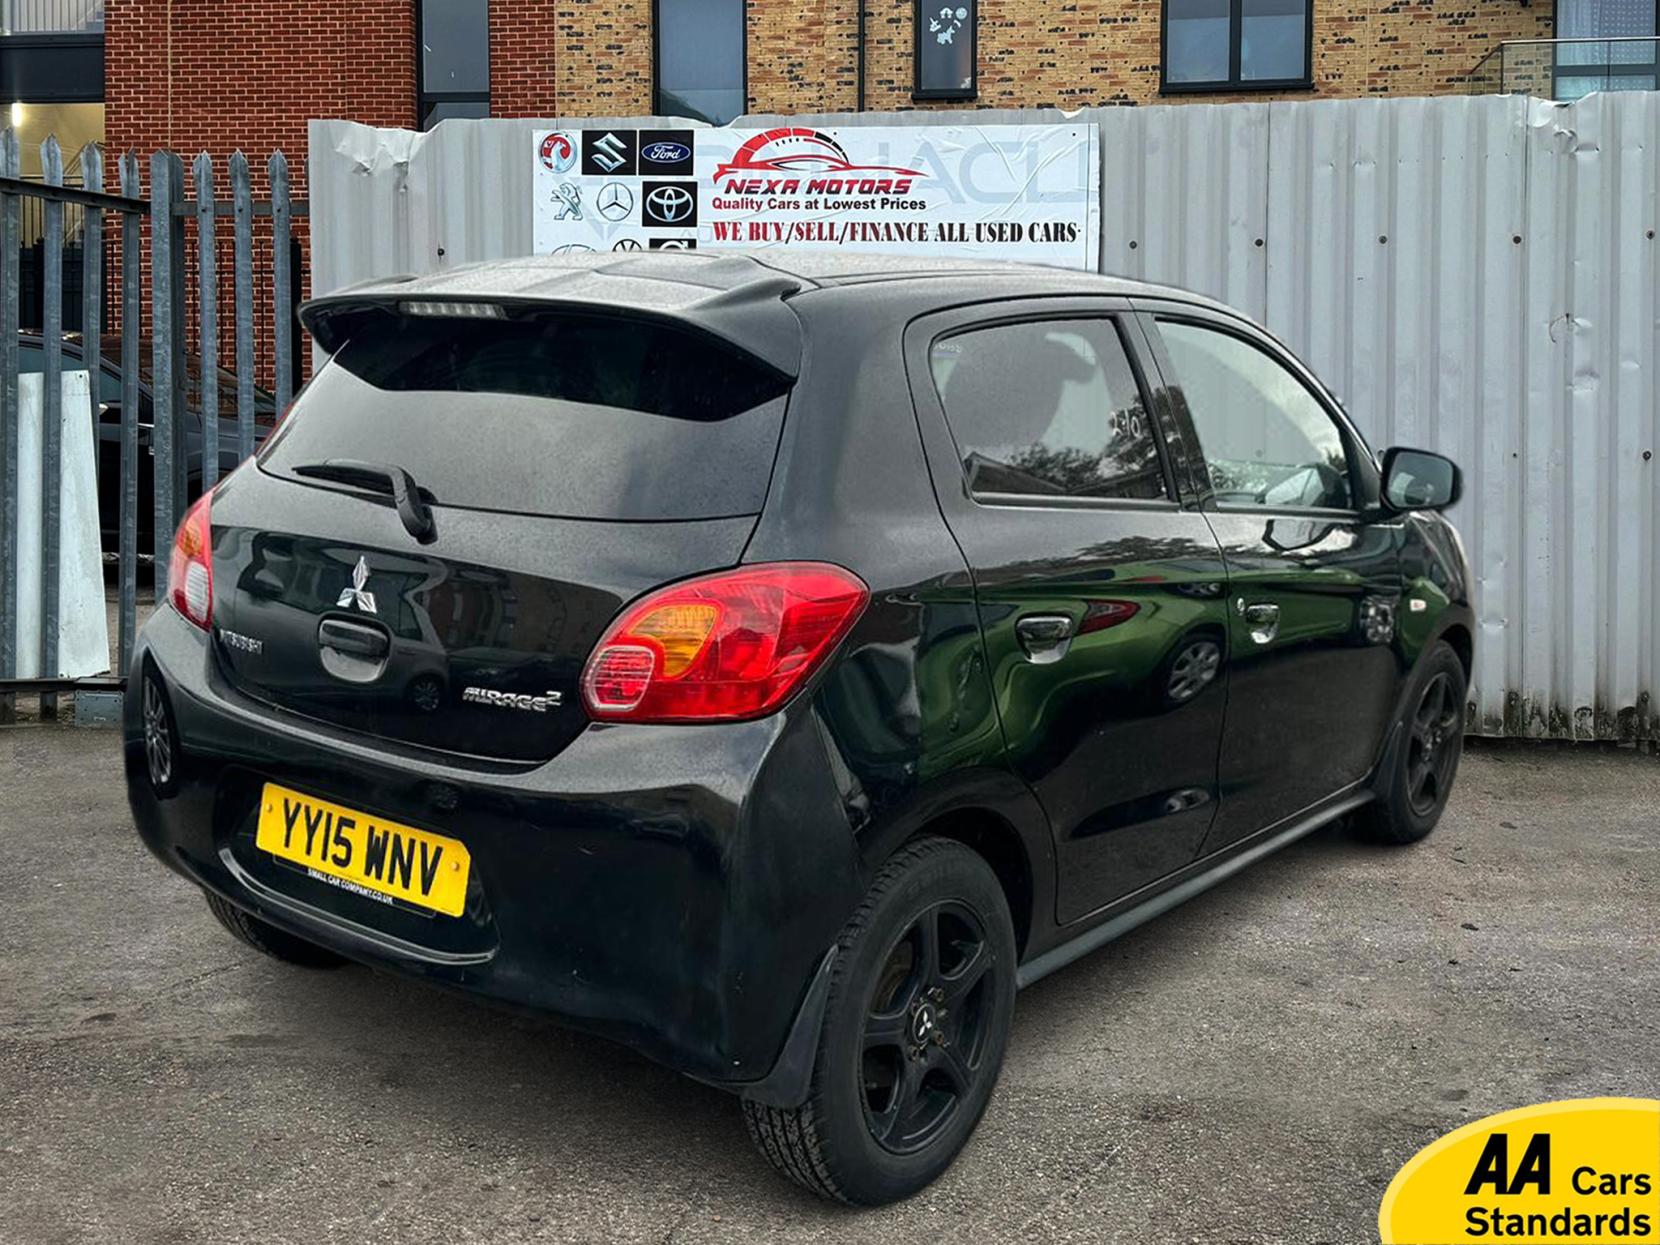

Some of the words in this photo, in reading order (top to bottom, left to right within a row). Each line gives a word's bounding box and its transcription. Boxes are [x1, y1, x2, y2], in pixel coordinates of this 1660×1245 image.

[651, 145, 681, 159] Ford
[724, 179, 797, 195] NEXA
[805, 179, 912, 195] MOTORS
[712, 197, 763, 211] Quality
[767, 198, 801, 210] Cars
[804, 199, 820, 210] at
[823, 198, 877, 210] Lowest
[880, 198, 927, 210] Prices
[713, 221, 743, 241] WE
[748, 221, 929, 245] BUY/SELL/FINANCE
[934, 222, 970, 243] ALL
[975, 222, 1023, 243] USED
[284, 798, 356, 868] YY15
[364, 825, 443, 896] WNV
